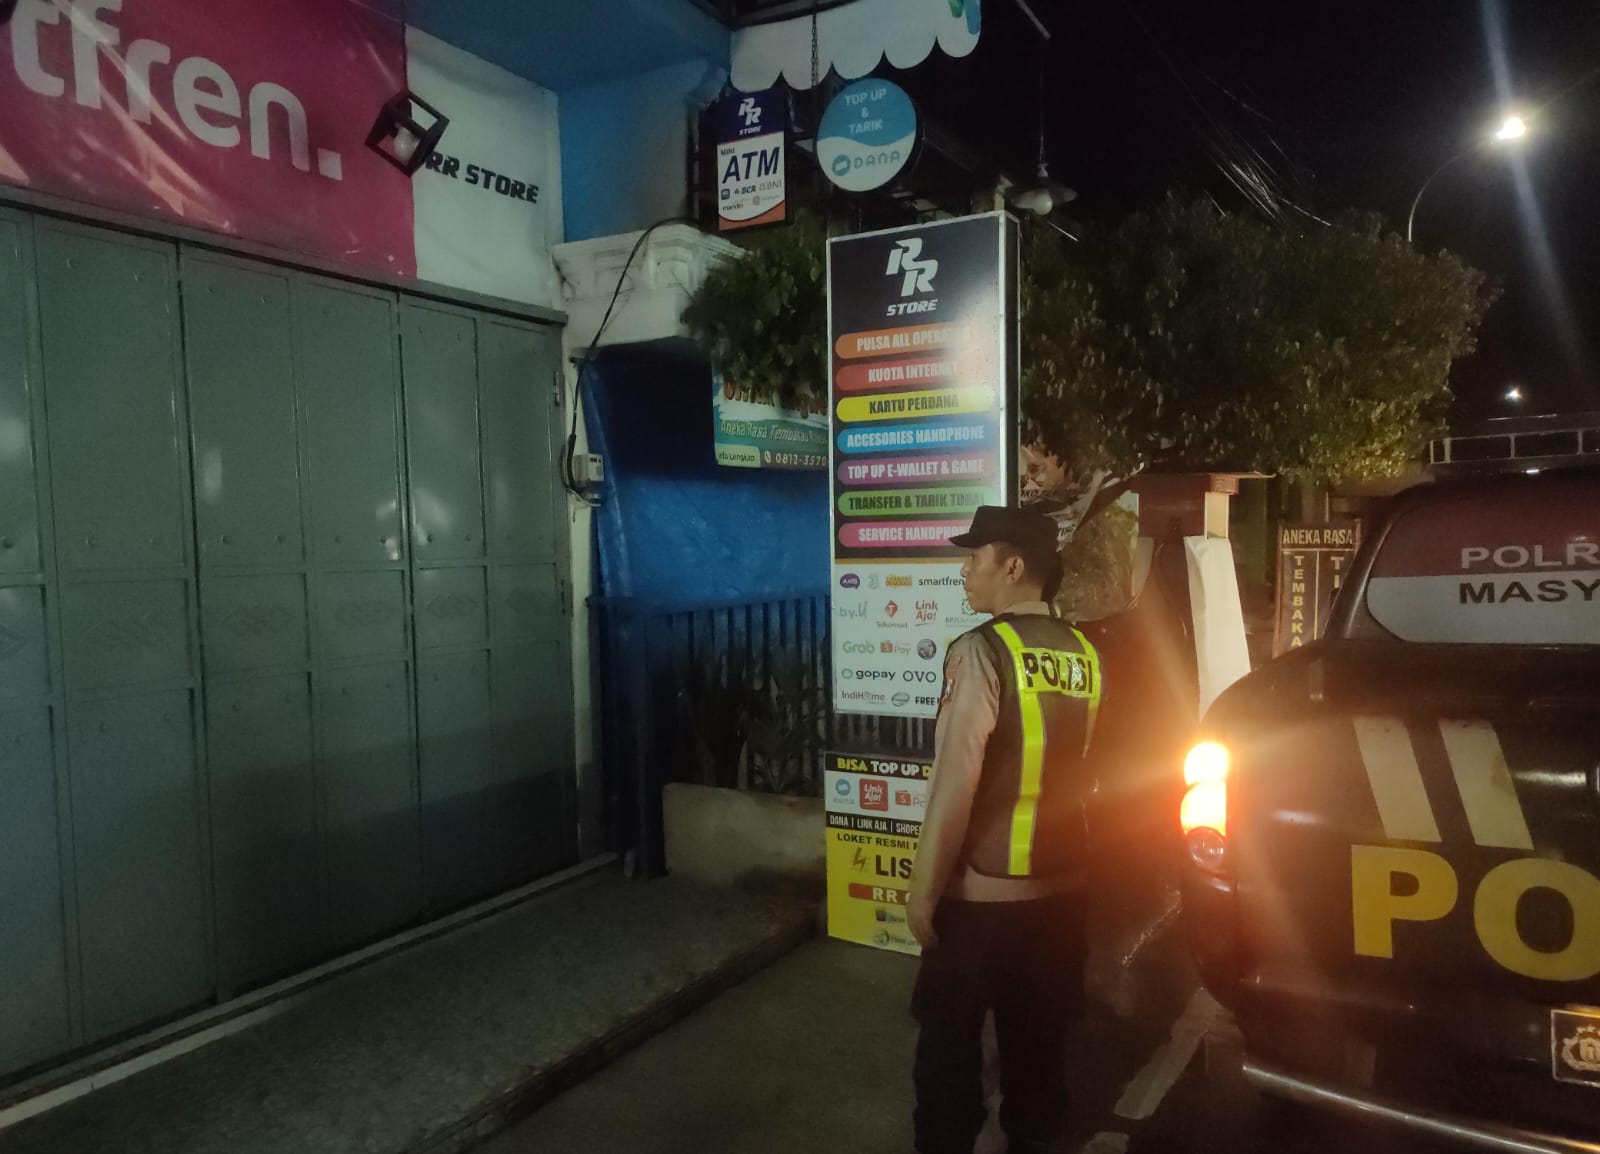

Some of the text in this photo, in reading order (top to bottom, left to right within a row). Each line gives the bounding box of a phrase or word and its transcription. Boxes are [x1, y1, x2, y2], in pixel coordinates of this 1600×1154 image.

[844, 88, 887, 106] TOP UP
[849, 119, 883, 134] TARIK
[722, 146, 780, 184] ATM
[854, 150, 901, 170] DANA
[425, 151, 539, 204] RR STORE
[886, 299, 939, 317] STORE
[857, 334, 890, 352] PULSA
[892, 332, 911, 348] ALL
[868, 366, 904, 383] KUOTA
[869, 394, 960, 415] KARTU PERDANA
[847, 430, 914, 448] ACCESORIES
[916, 425, 984, 444] HANDPHONE
[848, 459, 984, 479] TOP UP E-WALLET & GAME
[848, 496, 902, 511] TRANSFER
[904, 495, 911, 508] &
[915, 494, 947, 508] TARIK
[859, 526, 903, 542] SERVICE
[1282, 529, 1353, 544] ANEKA RASA
[1461, 542, 1600, 569] POLR
[1459, 578, 1600, 604] MASY
[842, 641, 875, 654] Grab
[855, 669, 896, 680] gopay
[902, 670, 937, 683] OVO
[1021, 652, 1092, 693] POLISI
[915, 696, 936, 706] FREE
[837, 757, 869, 772] BISA
[871, 760, 899, 774] TOP
[901, 762, 920, 776] UP
[830, 815, 848, 826] DANA
[857, 819, 873, 830] LINK
[874, 820, 887, 831] AJA
[837, 832, 871, 845] LOKET
[876, 837, 909, 850] RESMI
[872, 887, 898, 903] RR
